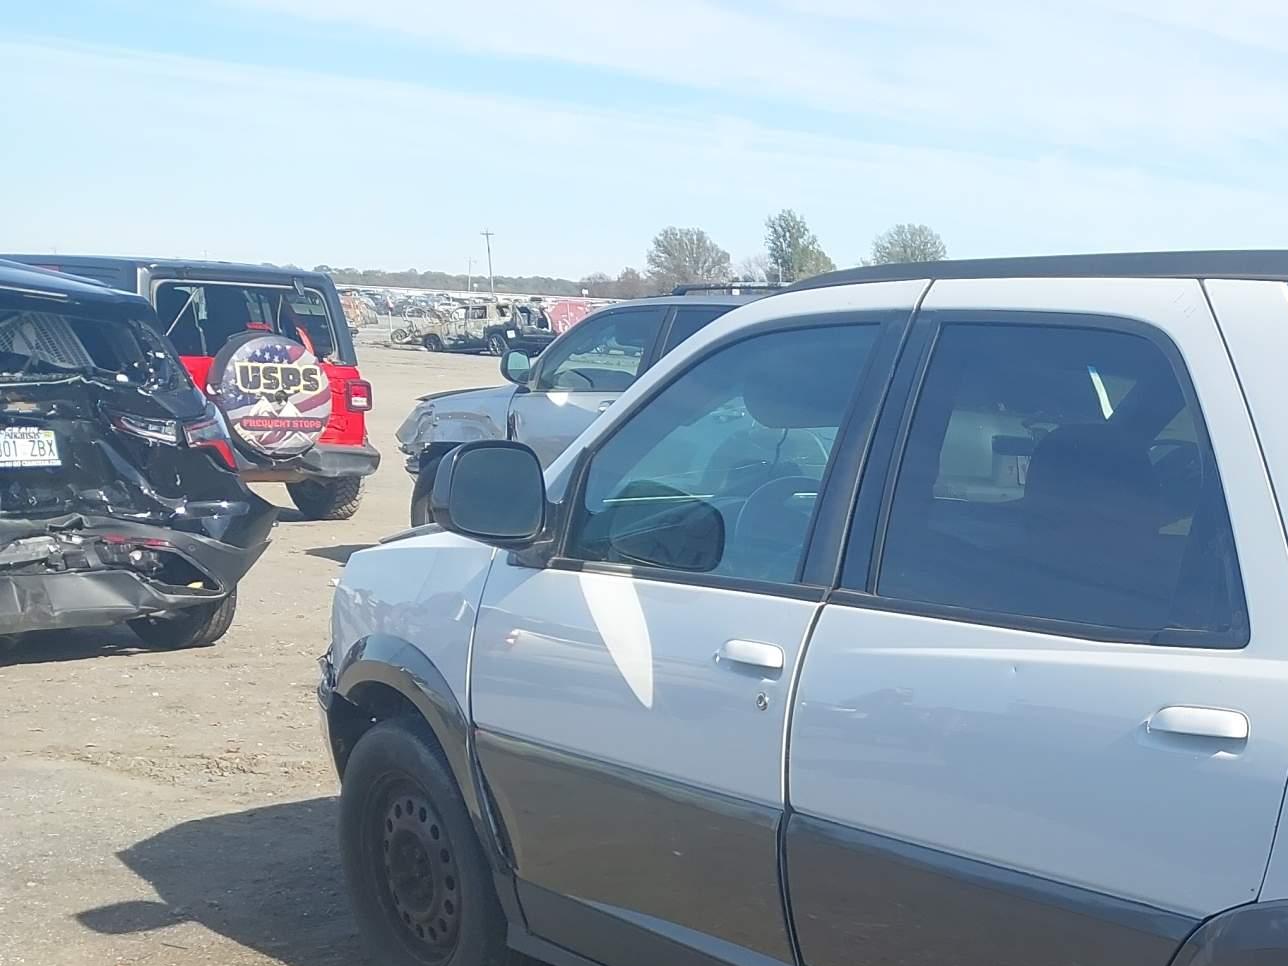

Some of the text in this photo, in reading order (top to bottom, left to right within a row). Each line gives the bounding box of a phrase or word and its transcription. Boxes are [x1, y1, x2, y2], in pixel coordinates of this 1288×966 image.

[239, 365, 320, 393] USPS
[292, 419, 322, 429] STOPS
[28, 440, 56, 457] ZBX
